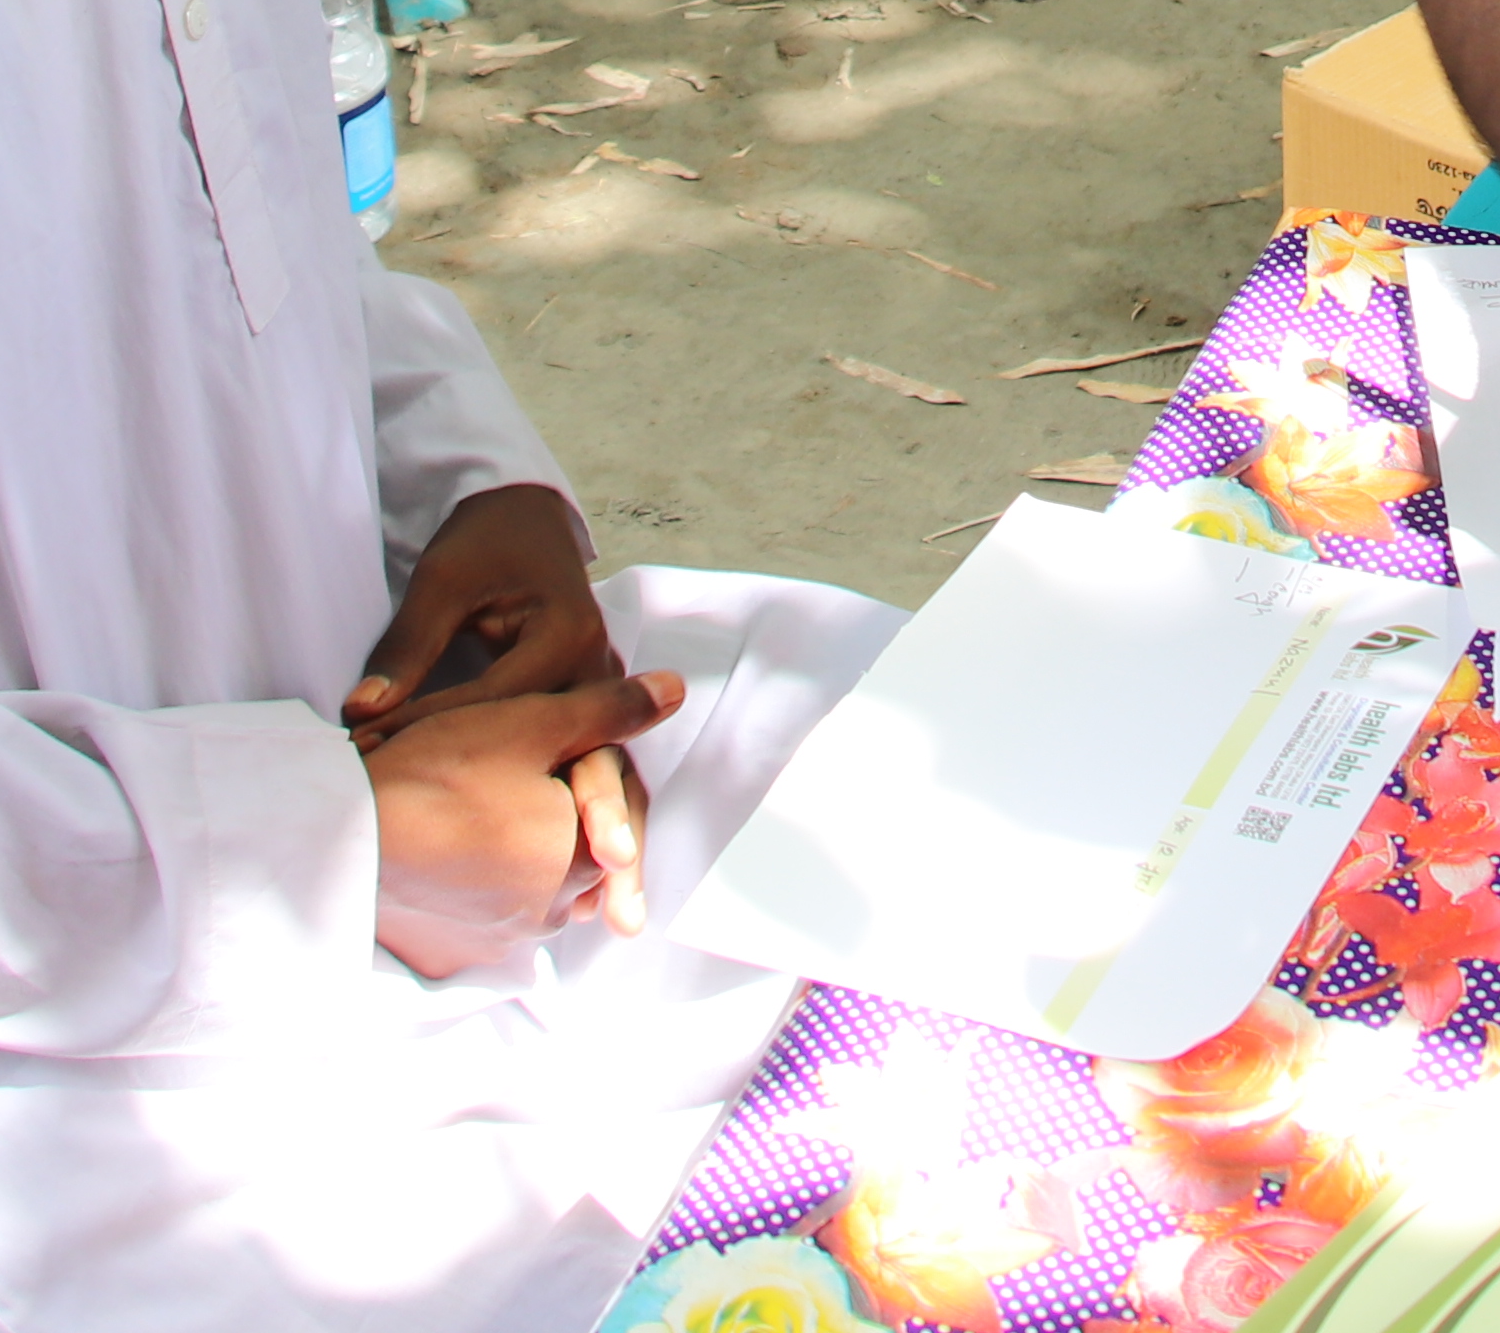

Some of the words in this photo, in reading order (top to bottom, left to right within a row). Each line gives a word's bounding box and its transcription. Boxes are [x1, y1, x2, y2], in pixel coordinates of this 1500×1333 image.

[1255, 690, 1330, 798] www.healthlabs.com.bd
[1347, 699, 1402, 748] health
[1326, 748, 1373, 782] labs
[1308, 783, 1352, 810] ltd.
